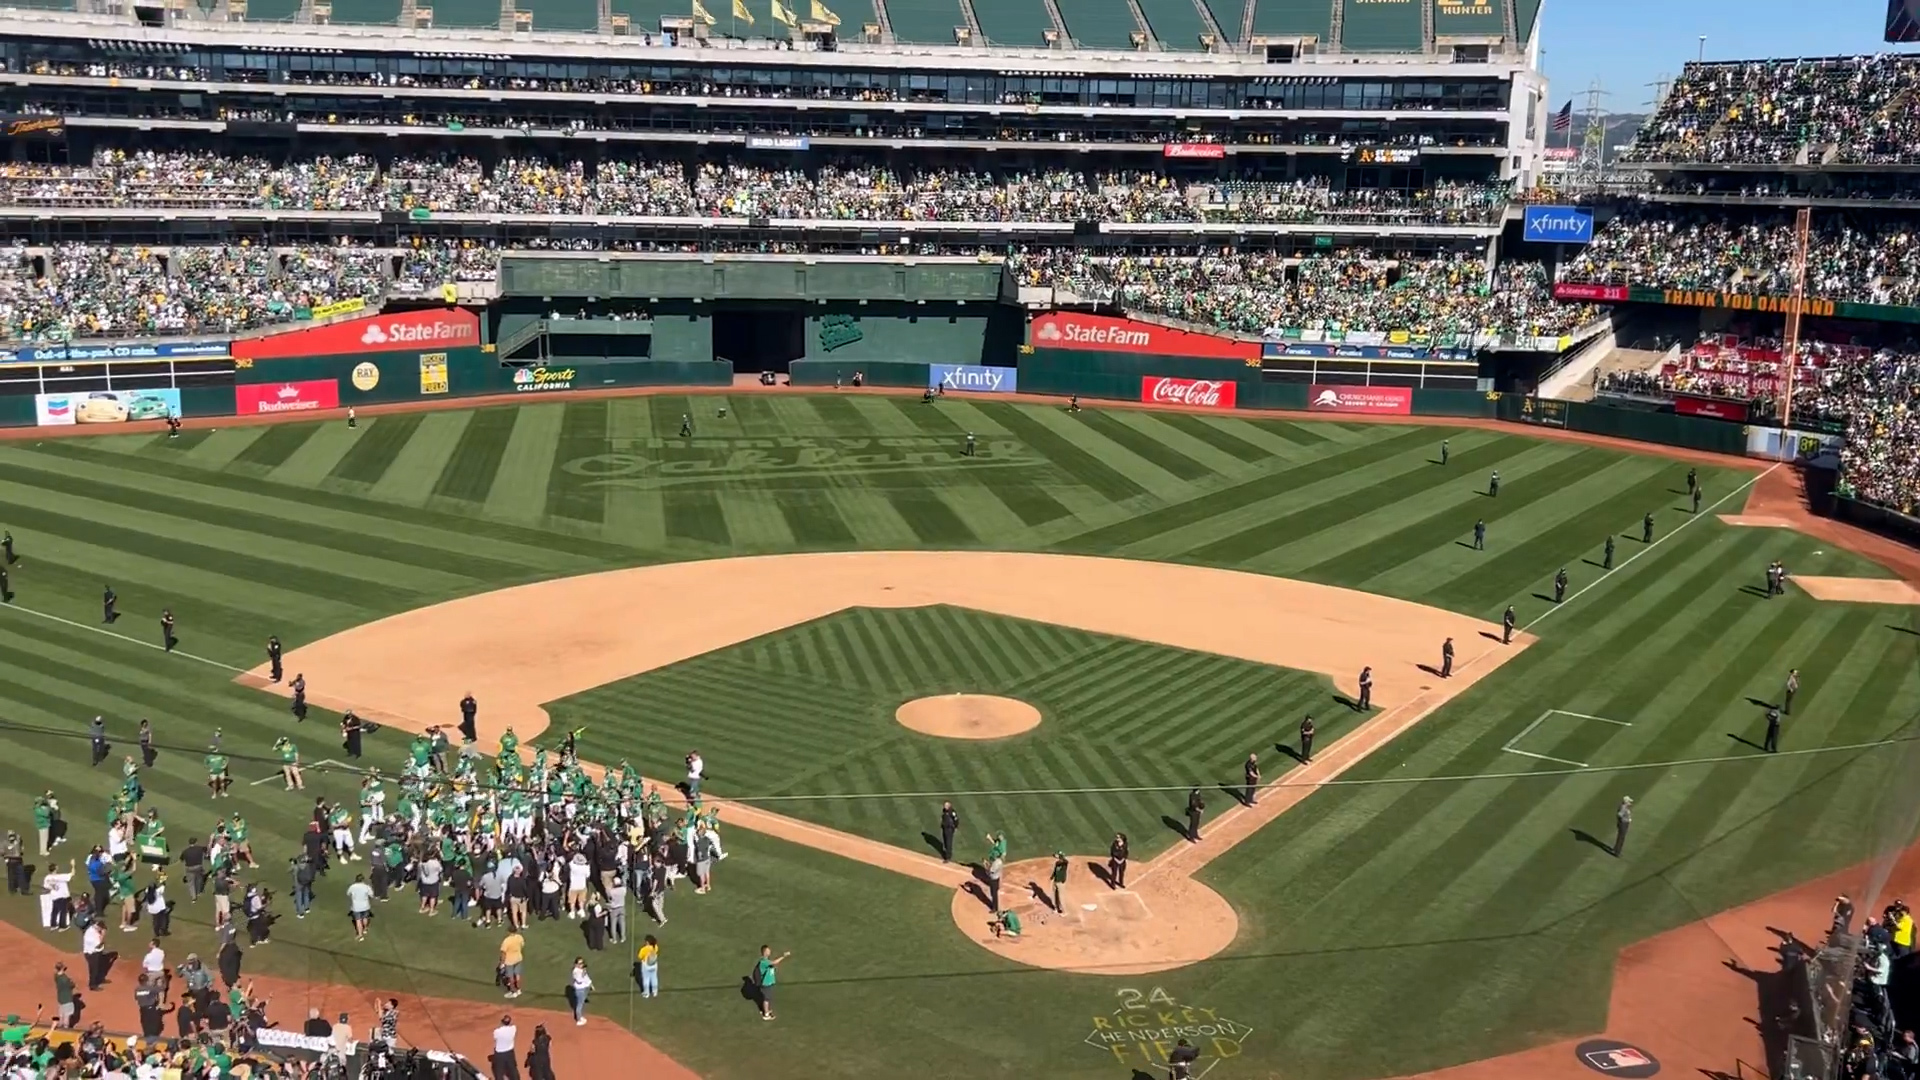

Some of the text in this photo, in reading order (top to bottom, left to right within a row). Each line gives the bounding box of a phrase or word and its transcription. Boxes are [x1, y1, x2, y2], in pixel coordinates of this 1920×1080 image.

[1443, 6, 1493, 15] HUNTER
[1531, 213, 1588, 235] xfinity
[1663, 289, 1834, 316] THANK YOU OAKLAND
[235, 358, 254, 368] 362
[533, 367, 576, 384] Sports
[943, 367, 1004, 391] xfinity
[516, 382, 571, 392] CALIFORNIA
[257, 399, 320, 412] Budweiser
[561, 440, 1030, 478] Oakland
[1117, 986, 1176, 1010] 24
[1093, 1007, 1218, 1030] RICKEY
[1100, 1023, 1237, 1042] HENDERSON
[1110, 1037, 1242, 1065] FIED
